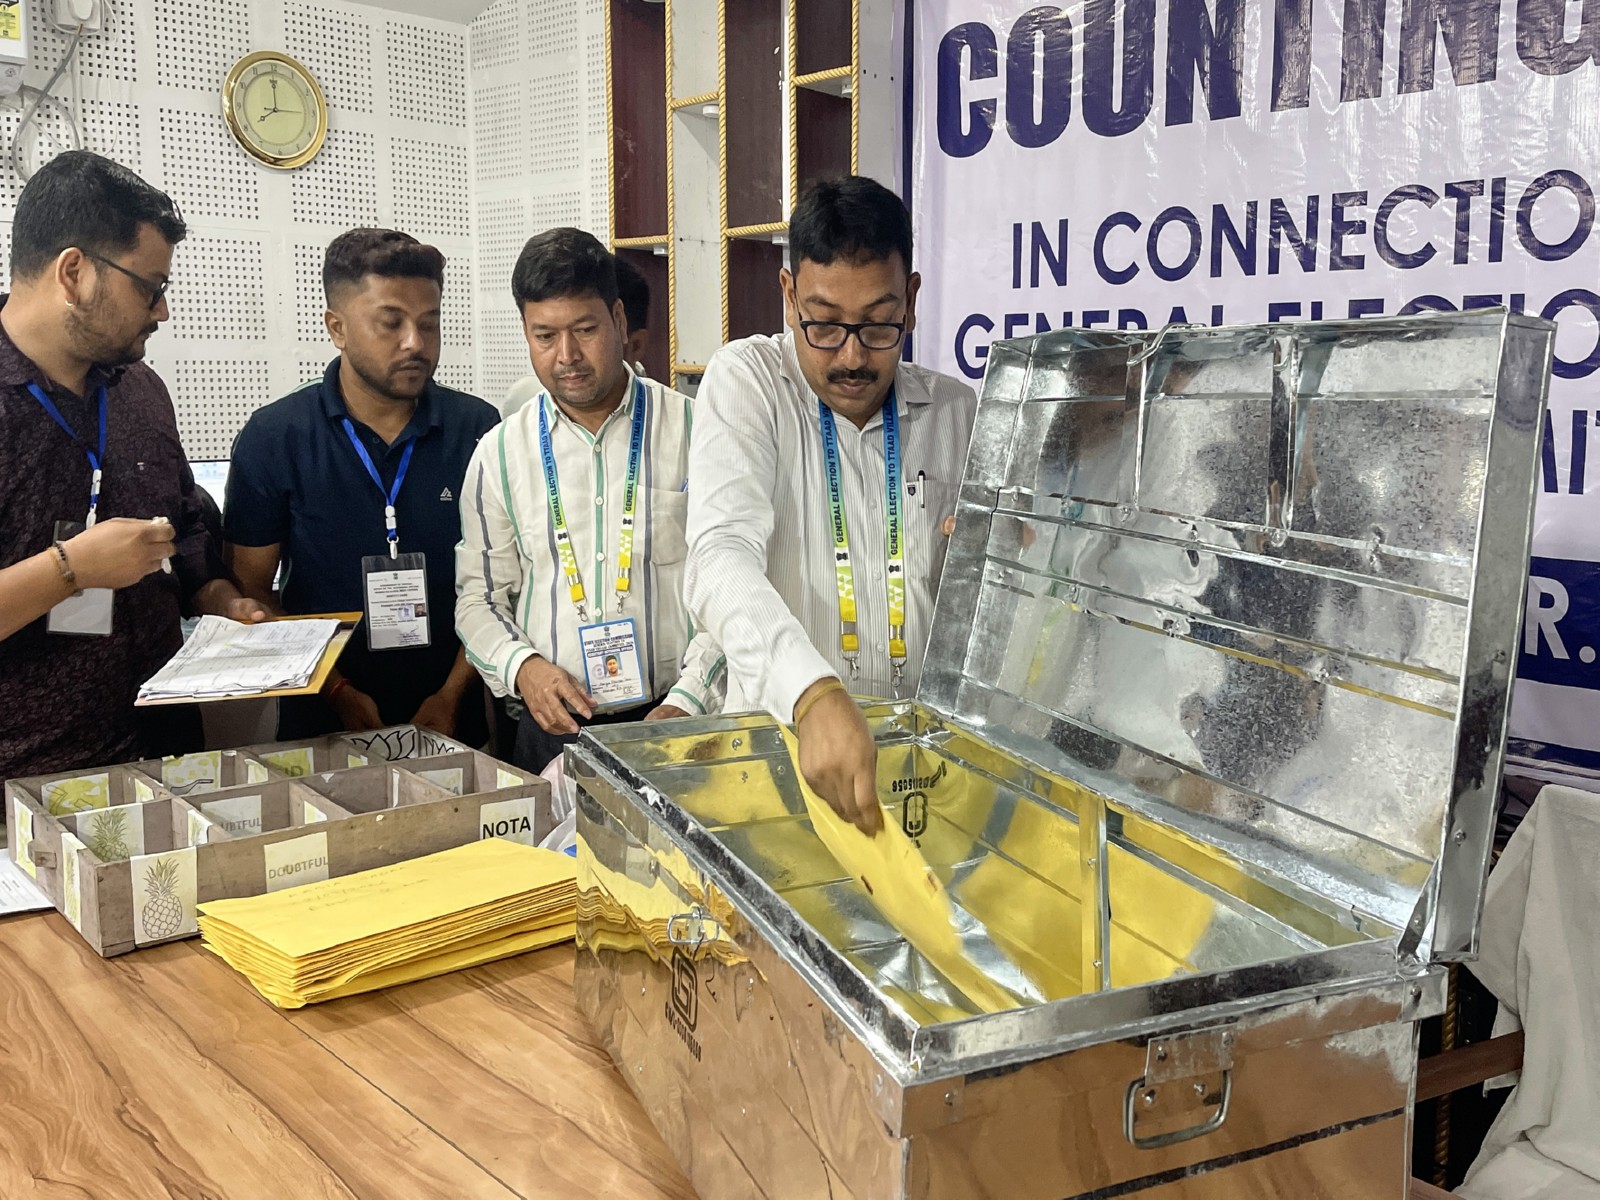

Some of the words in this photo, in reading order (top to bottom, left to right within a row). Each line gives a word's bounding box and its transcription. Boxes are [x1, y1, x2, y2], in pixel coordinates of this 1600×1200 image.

[1011, 218, 1069, 289] IN
[1093, 169, 1596, 286] CONNECTIO
[632, 441, 639, 451] TO
[824, 420, 834, 445] TTAAD
[545, 455, 552, 465] TO
[828, 448, 836, 460] TO
[887, 434, 896, 461] TTAAD
[629, 451, 638, 481] ELECTION
[888, 462, 896, 475] TO
[547, 465, 558, 496] ELECTION
[828, 461, 840, 502] ELECTION
[625, 482, 635, 512] GENERAL
[888, 475, 897, 516] ELECTION
[552, 496, 563, 526] GENERAL
[833, 504, 845, 543] GENERAL
[890, 517, 898, 556] GENERAL
[220, 816, 263, 832] UBTFUL
[482, 816, 532, 840] NOTA
[268, 855, 329, 880] DOUBTFUL
